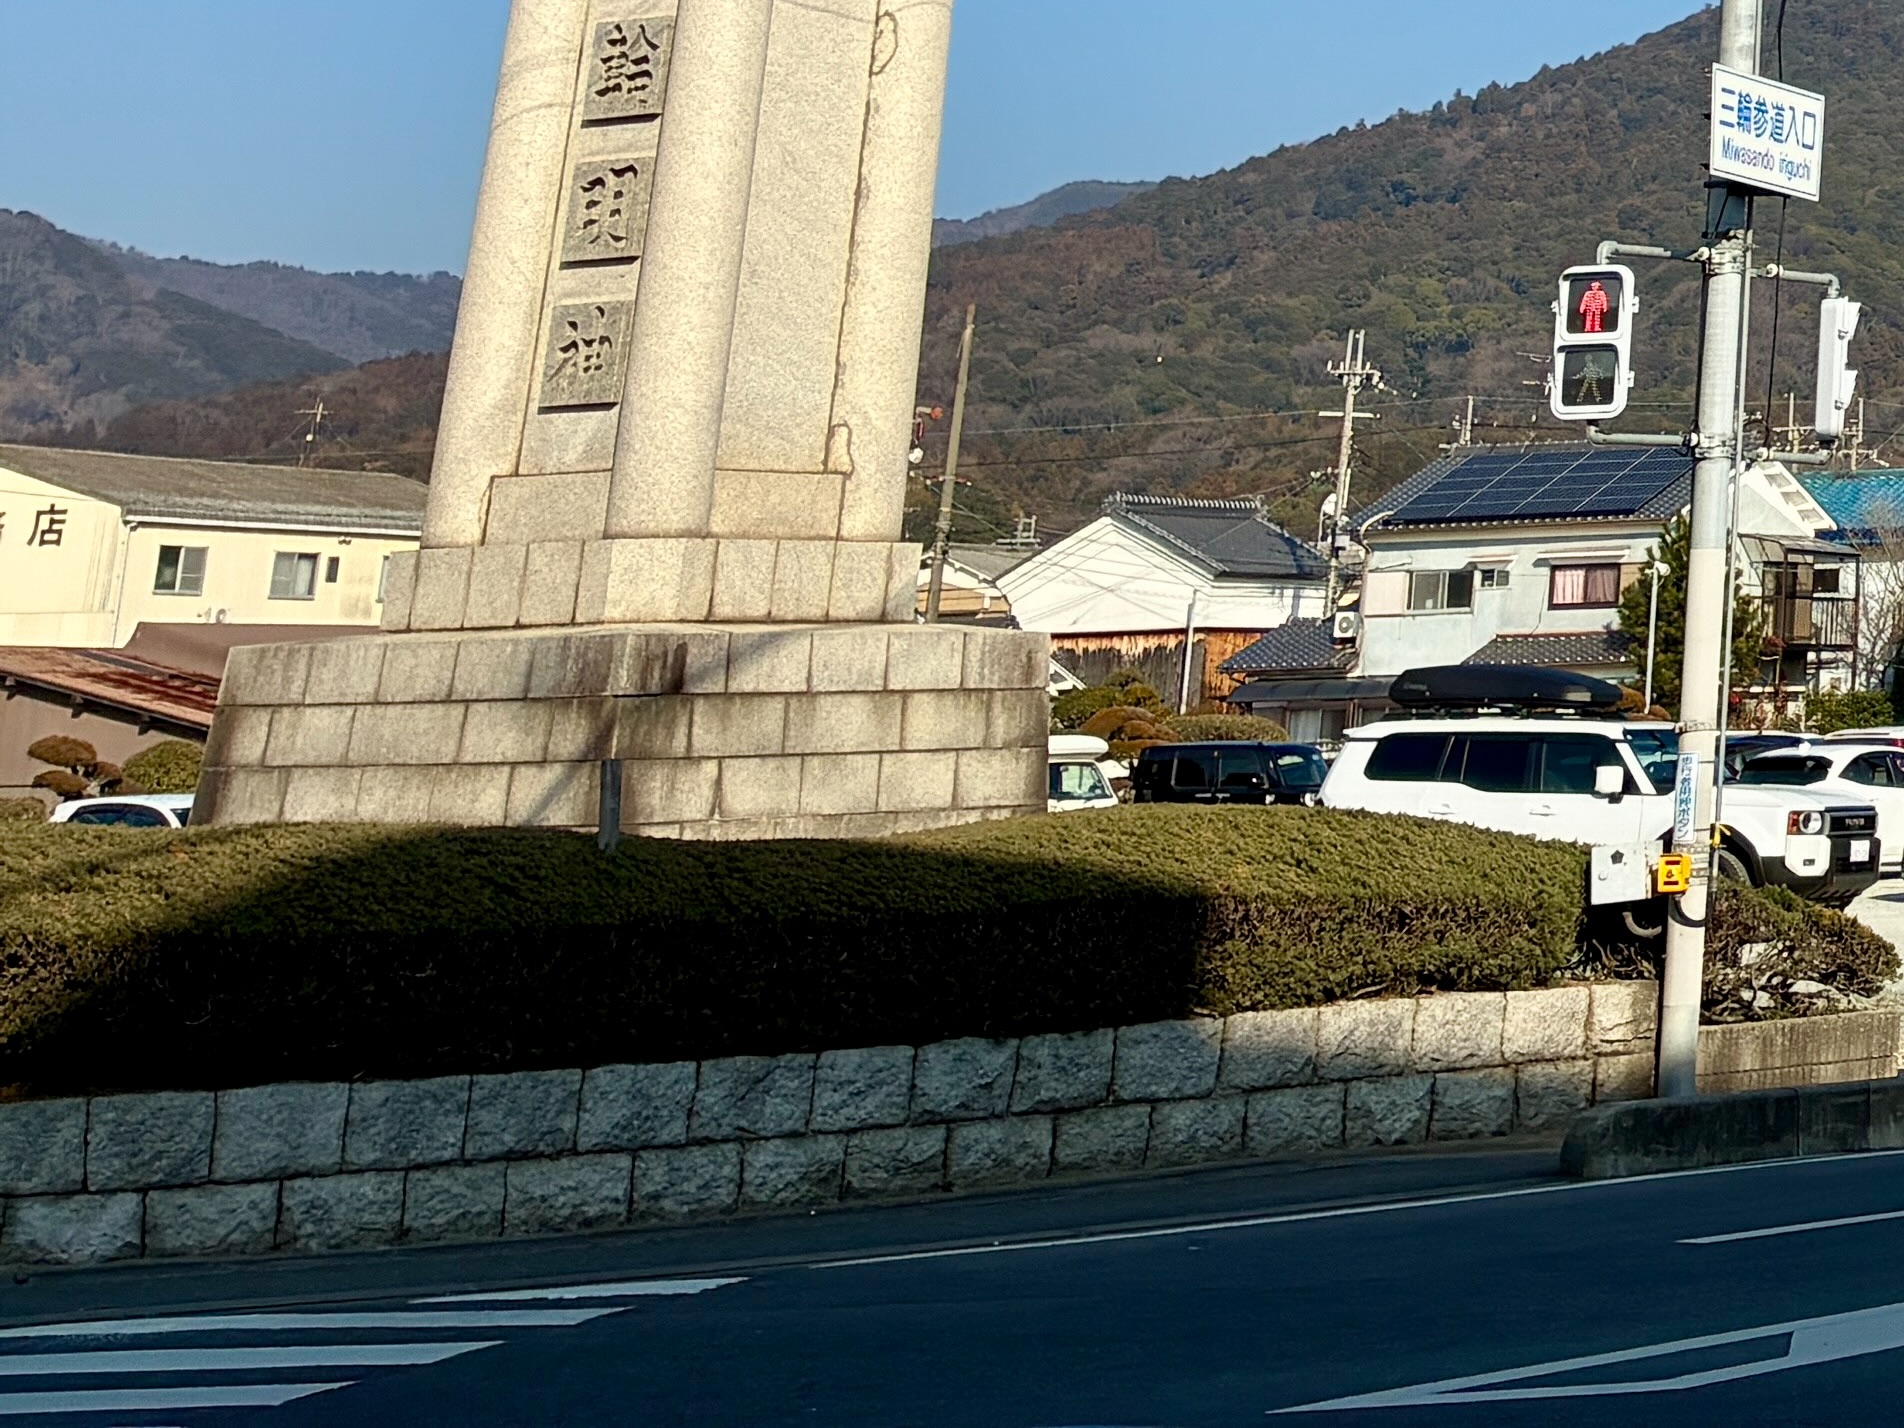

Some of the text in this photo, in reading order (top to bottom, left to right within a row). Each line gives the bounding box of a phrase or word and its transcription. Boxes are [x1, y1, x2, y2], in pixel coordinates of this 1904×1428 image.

[1719, 87, 1816, 150] 三輪参道入口
[1721, 135, 1776, 171] Miwasando
[0, 503, 68, 547] 店
